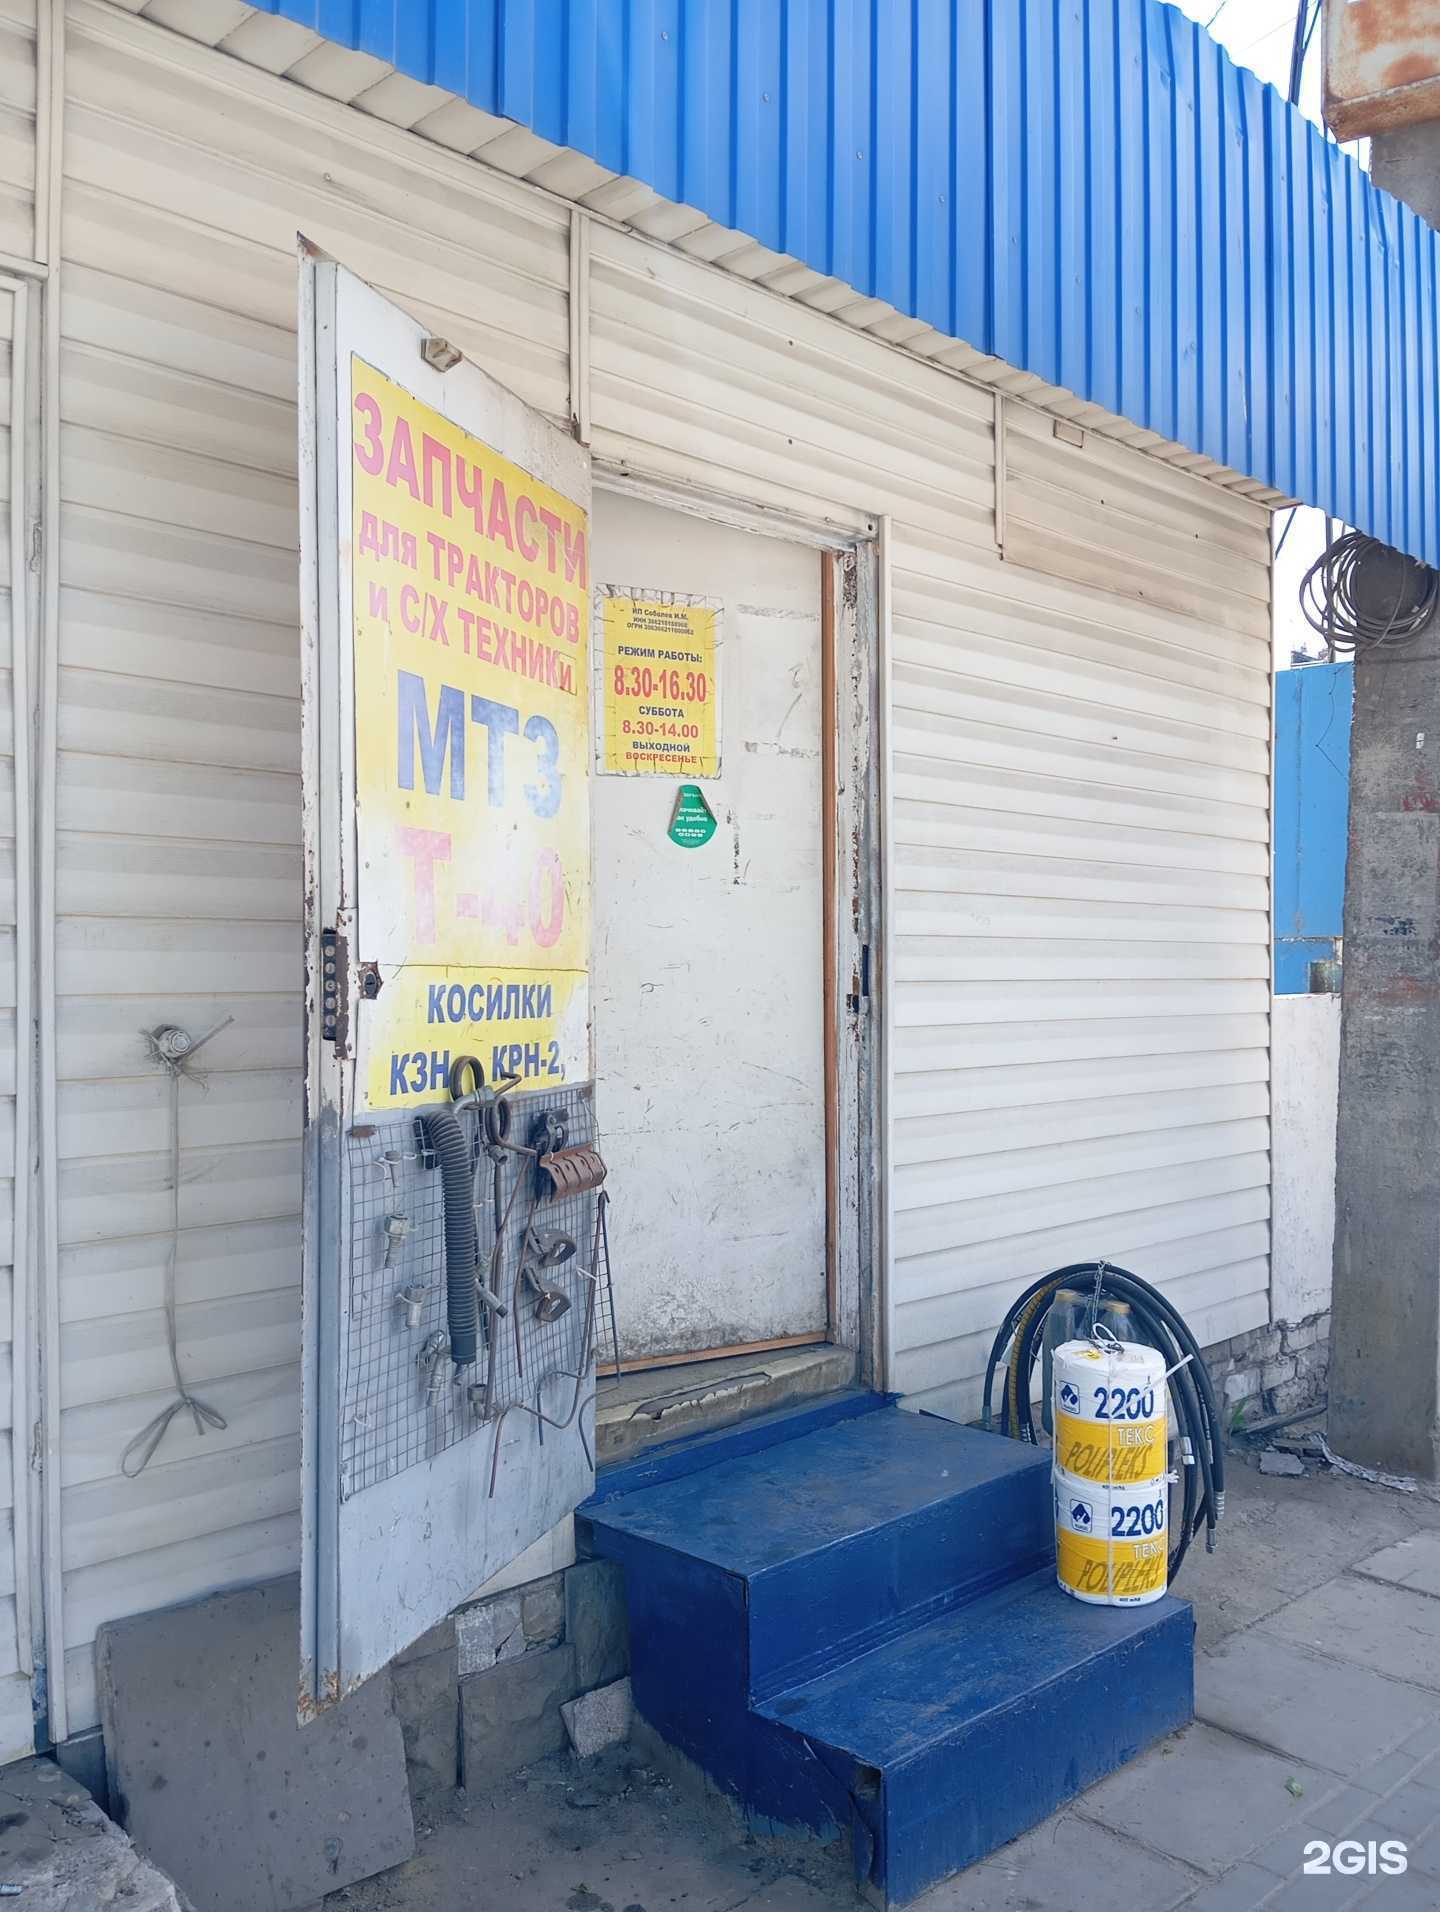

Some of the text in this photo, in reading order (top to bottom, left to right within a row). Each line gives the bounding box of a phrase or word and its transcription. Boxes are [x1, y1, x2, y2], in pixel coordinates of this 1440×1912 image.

[353, 391, 587, 591] ЗАПЧАСТИ
[426, 530, 580, 644] ТРАКТОРОВ
[400, 584, 450, 646] С/Х
[618, 645, 703, 663] РЕЖИМ РАБОТЫ:
[614, 665, 707, 702] 8.30-16.30
[622, 719, 699, 738] 8.30-14.00
[639, 705, 685, 718] СУББОТА
[398, 669, 562, 819] МТЗ
[625, 752, 698, 764] ВОСКРЕСЕНЬЕ
[632, 741, 690, 753] ВЫХОДНОЙ
[427, 983, 552, 1024] КОСИЛКИ
[1094, 1386, 1155, 1419] 2200
[1111, 1499, 1164, 1537] 2200
